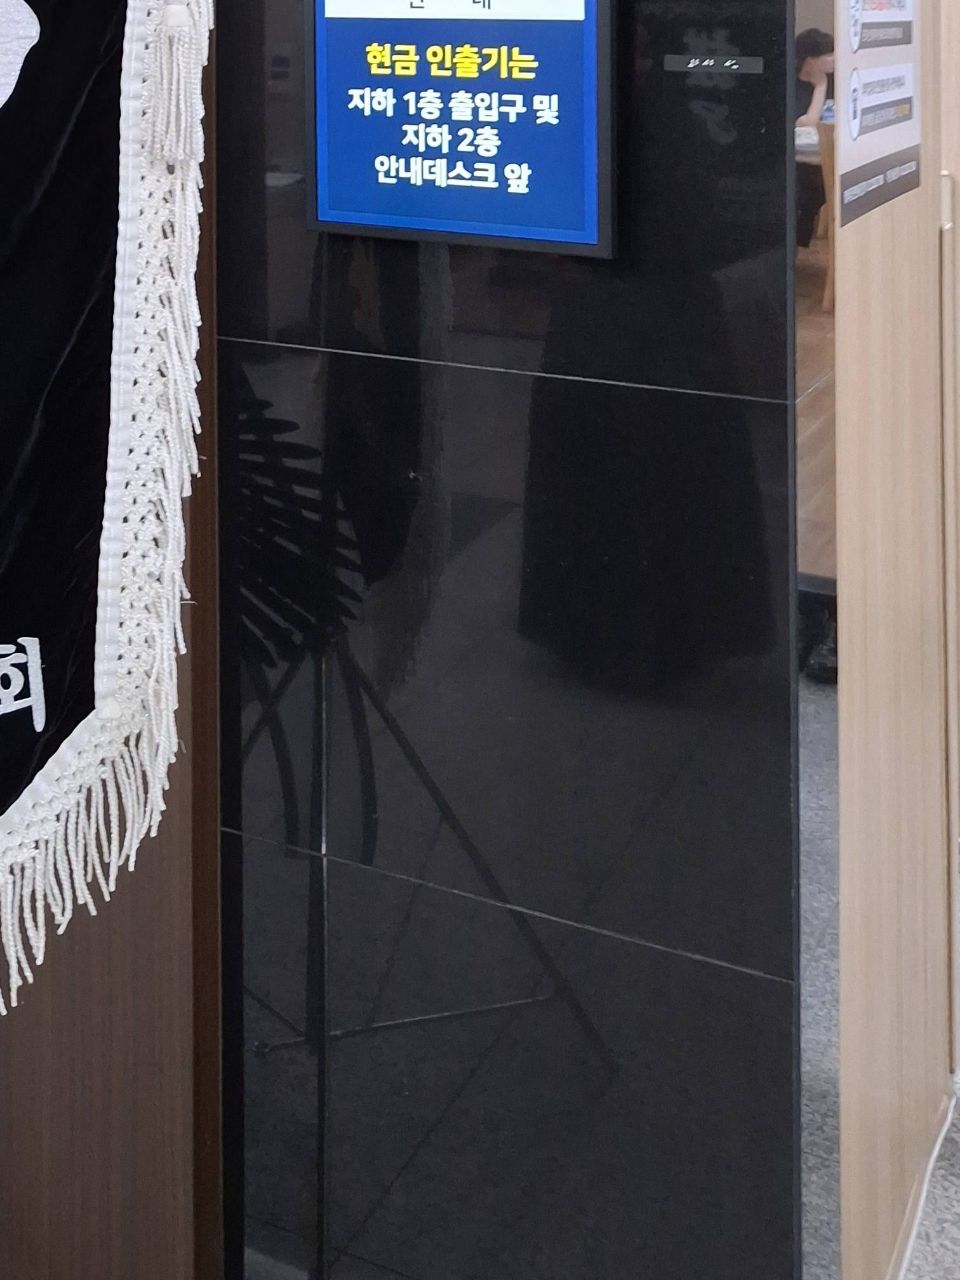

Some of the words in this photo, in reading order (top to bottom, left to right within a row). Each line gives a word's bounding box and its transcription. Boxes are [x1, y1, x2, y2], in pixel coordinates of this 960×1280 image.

[365, 42, 420, 76] 현금
[426, 43, 539, 80] 인출기는
[347, 87, 397, 118] 지하
[403, 90, 444, 120] 1층
[448, 90, 527, 123] 출입구
[532, 94, 560, 126] 및
[401, 123, 453, 153] 지하
[457, 125, 502, 157] 2층
[374, 155, 500, 189] 안내데스크
[503, 162, 533, 194] 앞
